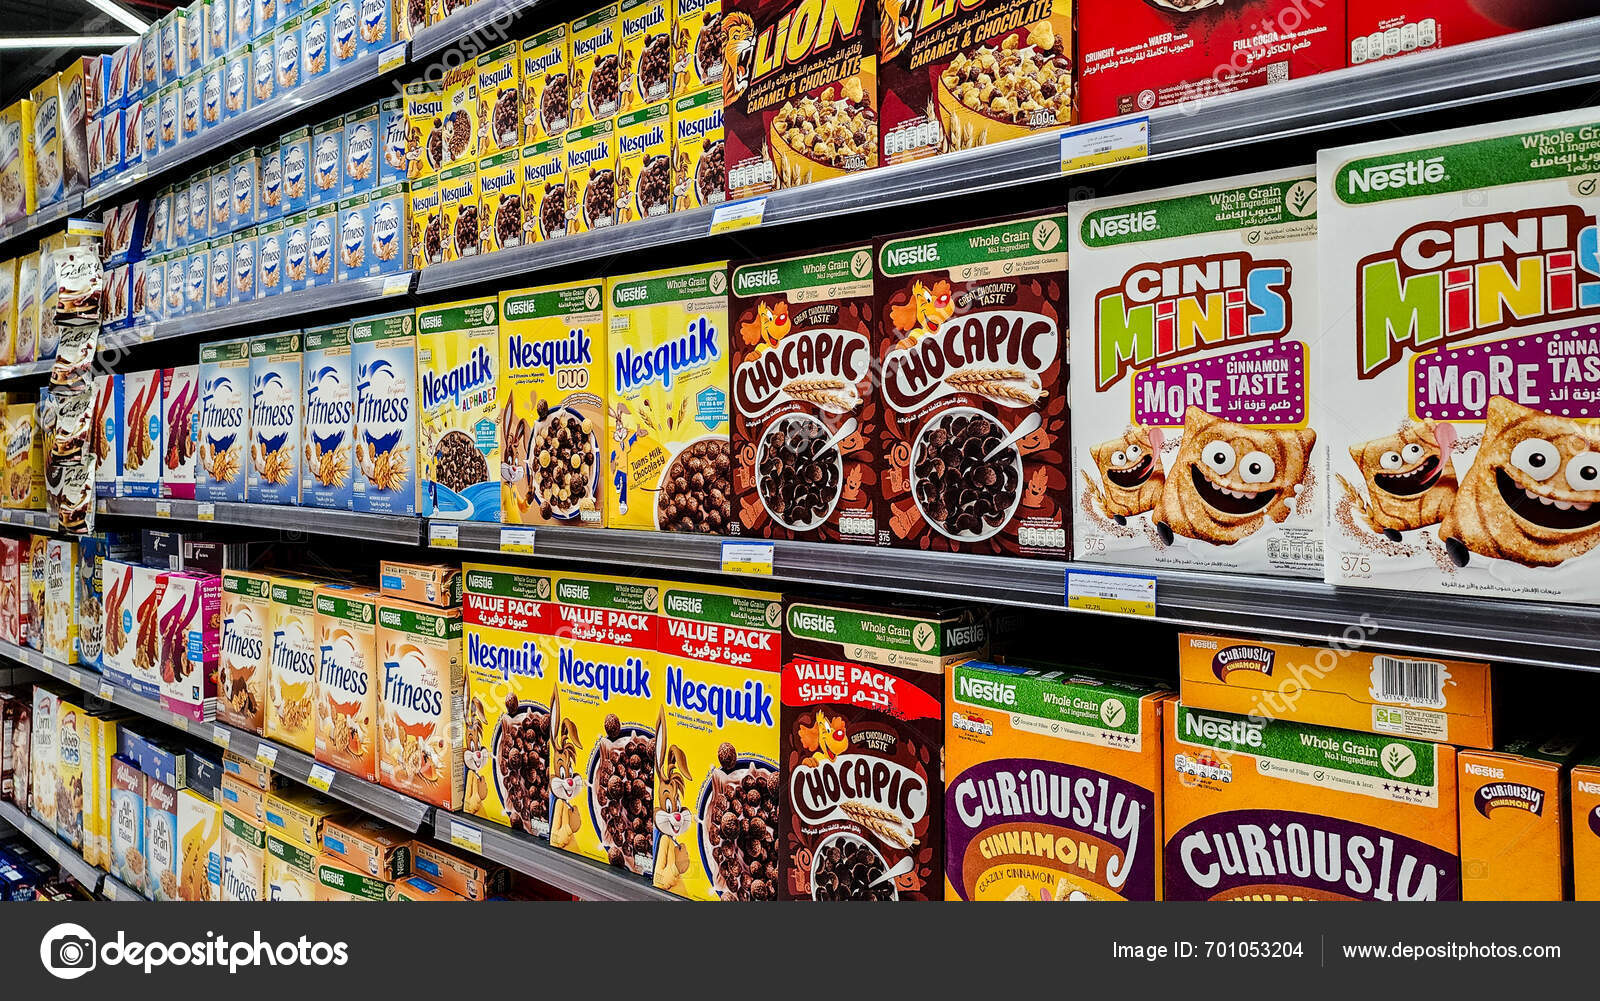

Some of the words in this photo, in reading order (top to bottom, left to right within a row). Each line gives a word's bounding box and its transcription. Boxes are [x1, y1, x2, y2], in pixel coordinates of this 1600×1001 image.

[622, 5, 665, 37] Nesquik
[574, 27, 613, 57] Nesquik
[910, 38, 958, 70] CARAMEL
[961, 31, 971, 48] &
[975, 0, 1052, 44] CHOCOLATE
[1233, 39, 1252, 51] FULL
[1253, 31, 1279, 47] COCOA
[1085, 48, 1115, 63] CRUNCHY
[1148, 33, 1172, 47] WAFER
[525, 47, 562, 75] Nesquik
[479, 63, 513, 89] Nesquik
[747, 90, 787, 114] CARAMEL
[788, 82, 797, 97] &
[798, 56, 862, 94] CHOCOLATE
[1029, 111, 1055, 126] 400g
[619, 126, 664, 153] Nesquik
[1520, 131, 1575, 149] Whole
[1539, 146, 1557, 156] No.
[568, 141, 608, 168] Nesquik
[481, 170, 515, 193] Nesquik
[524, 158, 562, 182] Nesquik
[441, 183, 473, 203] Nesquik
[1209, 190, 1246, 206] Whole
[1248, 187, 1282, 200] Grain
[1215, 210, 1247, 221] الكاملة
[1221, 203, 1234, 211] No.
[969, 234, 1000, 249] Whole
[1002, 230, 1030, 245] Grain
[1400, 214, 1568, 270] CINI
[802, 262, 826, 275] Whole
[827, 259, 849, 271] Grain
[667, 279, 687, 289] Whole
[688, 278, 706, 287] Grain
[1125, 258, 1242, 303] CINI
[958, 289, 977, 307] GREAT
[977, 283, 1016, 297] CHOCOLATEY
[979, 294, 1007, 308] TASTE
[794, 312, 808, 326] GREAT
[808, 304, 838, 318] CHOCOLATEY
[809, 313, 830, 325] TASTE
[509, 329, 592, 376] Nesquik
[616, 317, 718, 392] Nesquik
[885, 314, 1052, 398] CHOCAPIC
[422, 345, 493, 411] Nesquik
[737, 331, 868, 402] CHOCAPIC
[1226, 359, 1289, 375] CINNAMON
[558, 369, 588, 389] DUO
[1226, 374, 1289, 396] TASTE
[1428, 355, 1540, 411] MORE
[306, 386, 351, 426] Fitness
[356, 381, 409, 424] Fitness
[462, 387, 497, 412] ALPHABET
[1144, 373, 1222, 418] MORE
[1243, 399, 1266, 411] قرفة
[1268, 399, 1291, 411] طعم
[201, 394, 243, 428] Fitness
[252, 390, 295, 426] Fitness
[1085, 538, 1105, 551] 375
[1340, 556, 1371, 573] 375
[468, 595, 504, 613] VALUE
[508, 600, 541, 617] PACK
[478, 611, 507, 627] توفيرية
[508, 615, 528, 629] عبوة
[560, 606, 603, 626] VALUE
[608, 612, 648, 631] PACK
[861, 621, 886, 633] Whole
[888, 624, 911, 636] Grain
[221, 618, 263, 661] Fitness
[571, 623, 607, 641] توفيرية
[608, 629, 632, 644] عبوة
[668, 620, 718, 643] VALUE
[724, 628, 771, 650] PACK
[272, 630, 315, 677] Fitness
[468, 632, 544, 682] Nesquik
[682, 640, 722, 660] توفيرية
[724, 647, 752, 664] عبوة
[319, 645, 369, 697] Fitness
[560, 647, 651, 702] Nesquik
[1226, 661, 1261, 671] CINNAMON
[384, 661, 443, 717] Fitness
[795, 663, 845, 682] VALUE
[850, 667, 897, 694] PACK
[667, 665, 773, 728] Nesquik
[798, 680, 849, 702] توفيري
[852, 690, 889, 706] حجم
[1043, 692, 1071, 708] Whole
[1073, 698, 1098, 712] Grain
[851, 732, 866, 744] GREAT
[865, 731, 896, 745] CHOCOLATEY
[866, 739, 888, 752] TASTE
[1300, 733, 1340, 751] Whole
[1342, 741, 1378, 758] Grain
[794, 758, 922, 820] CHOCAPIC
[1491, 799, 1530, 809] CINNAMON
[979, 830, 1099, 874] CINNAMON
[1006, 868, 1055, 886] CINNAMON
